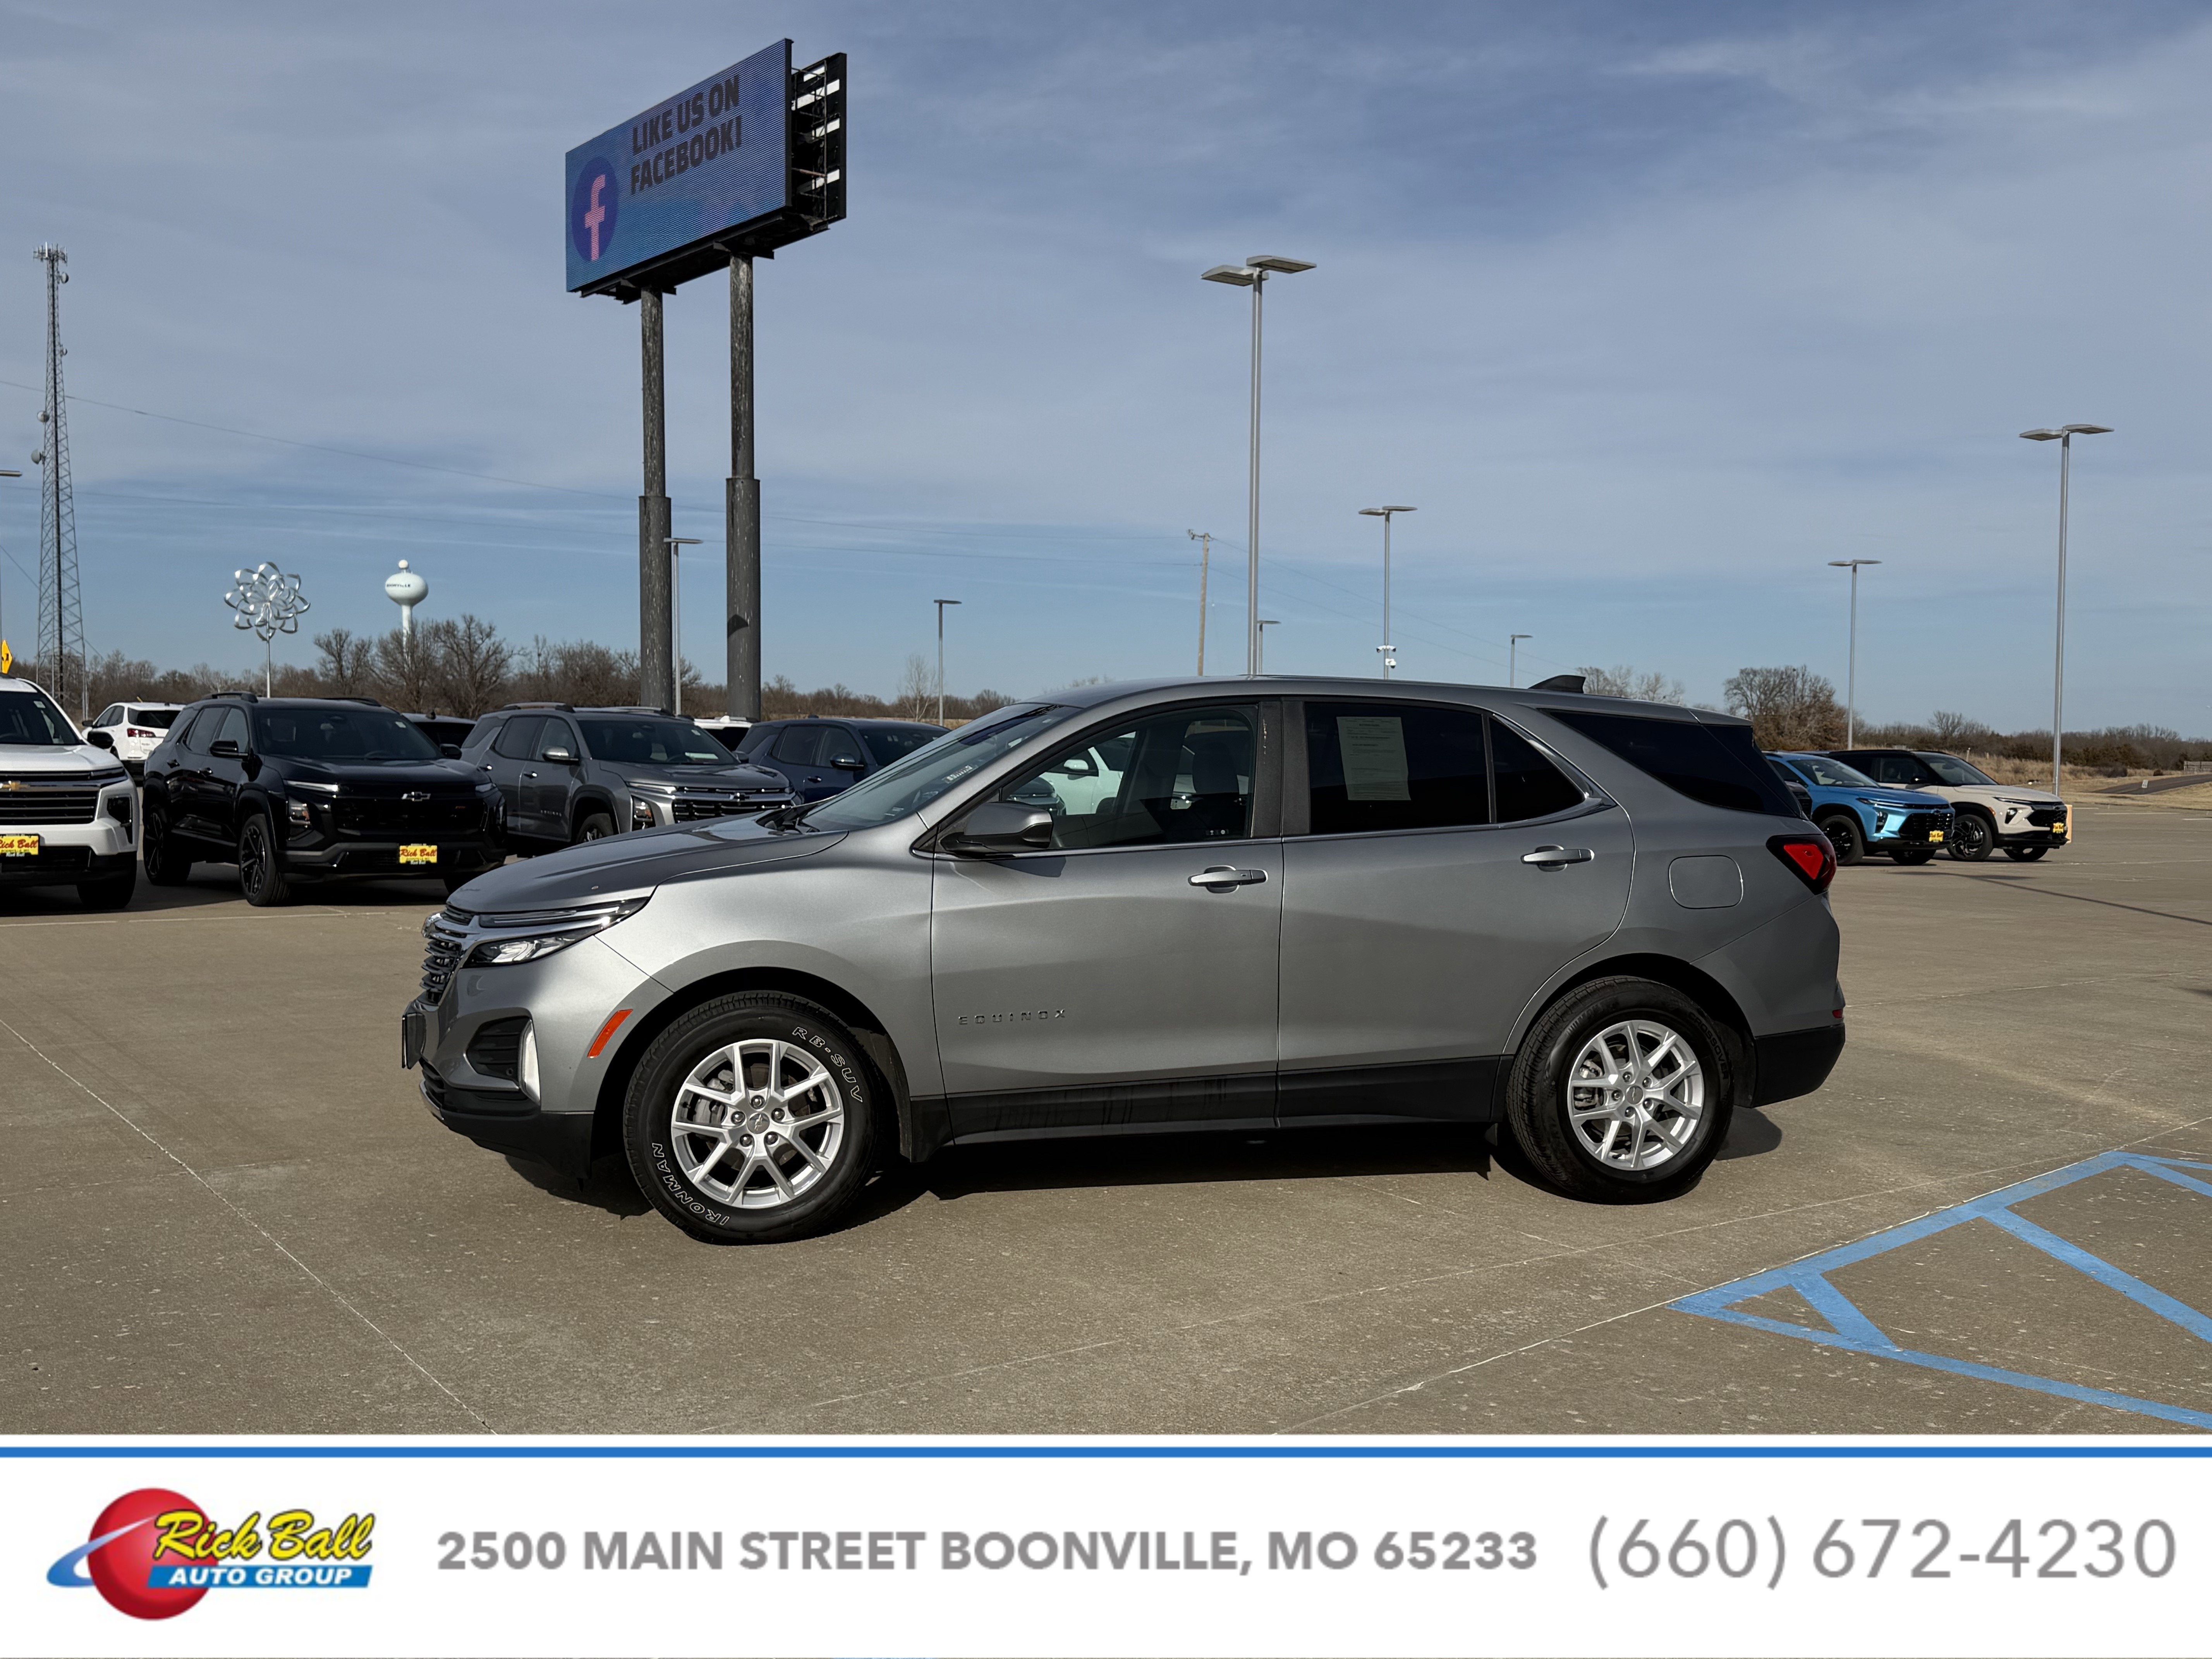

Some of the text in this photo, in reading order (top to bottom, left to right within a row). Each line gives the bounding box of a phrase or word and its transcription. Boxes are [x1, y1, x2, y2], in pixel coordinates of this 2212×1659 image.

[632, 75, 739, 154] LIKE US ON
[17, 839, 38, 848] Ball
[400, 848, 437, 857] Rick Ball
[958, 1009, 1065, 1025] EQUINOX
[1688, 1011, 1729, 1080] CROSSOVER
[652, 1143, 731, 1226] IRONMAN
